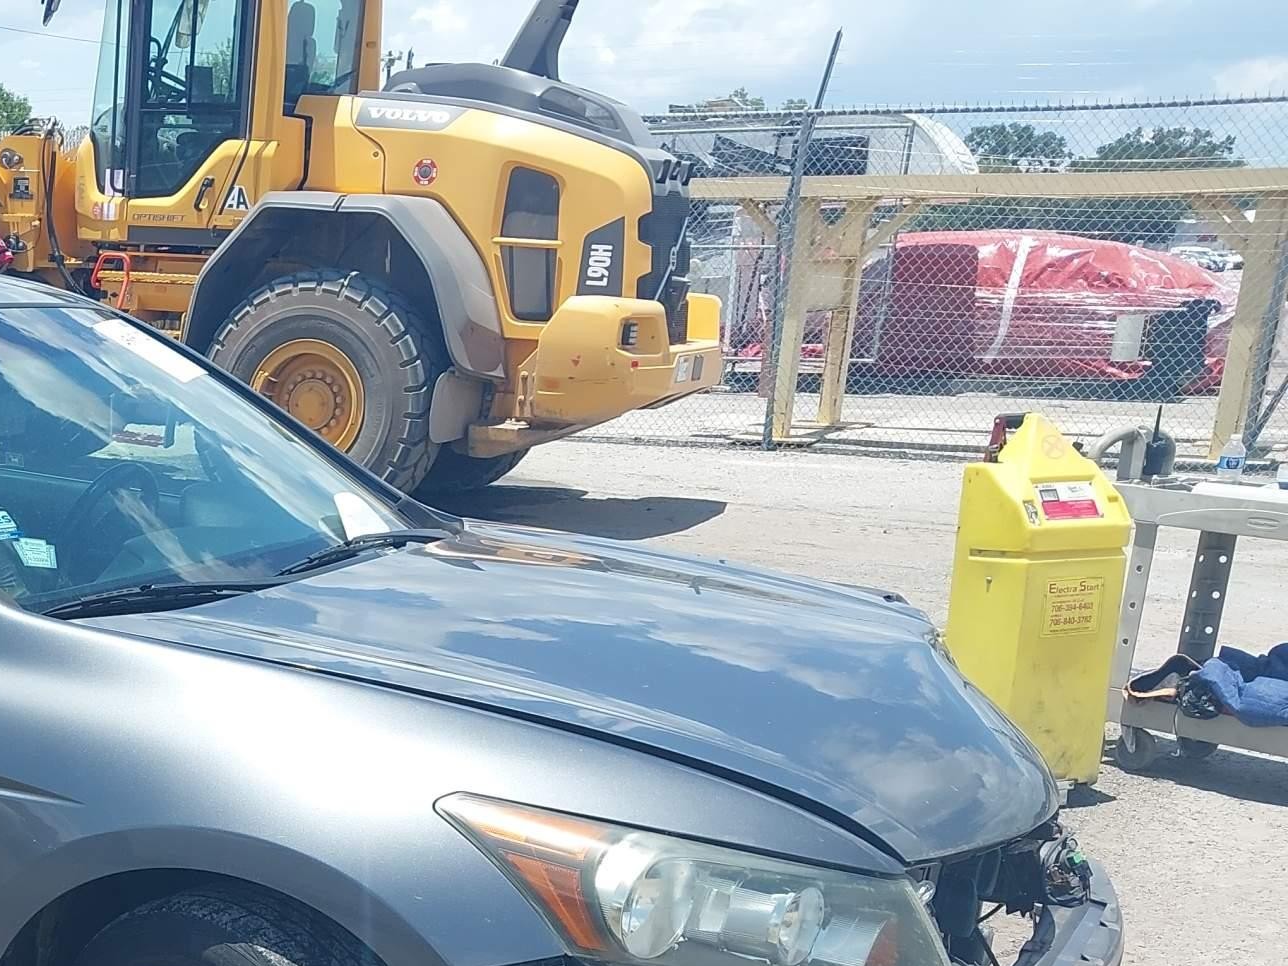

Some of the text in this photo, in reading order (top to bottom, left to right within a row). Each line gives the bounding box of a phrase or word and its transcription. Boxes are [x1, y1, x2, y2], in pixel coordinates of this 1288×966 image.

[367, 106, 450, 123] VOLVO
[585, 244, 613, 287] L90H
[1049, 580, 1100, 594] Electra Start
